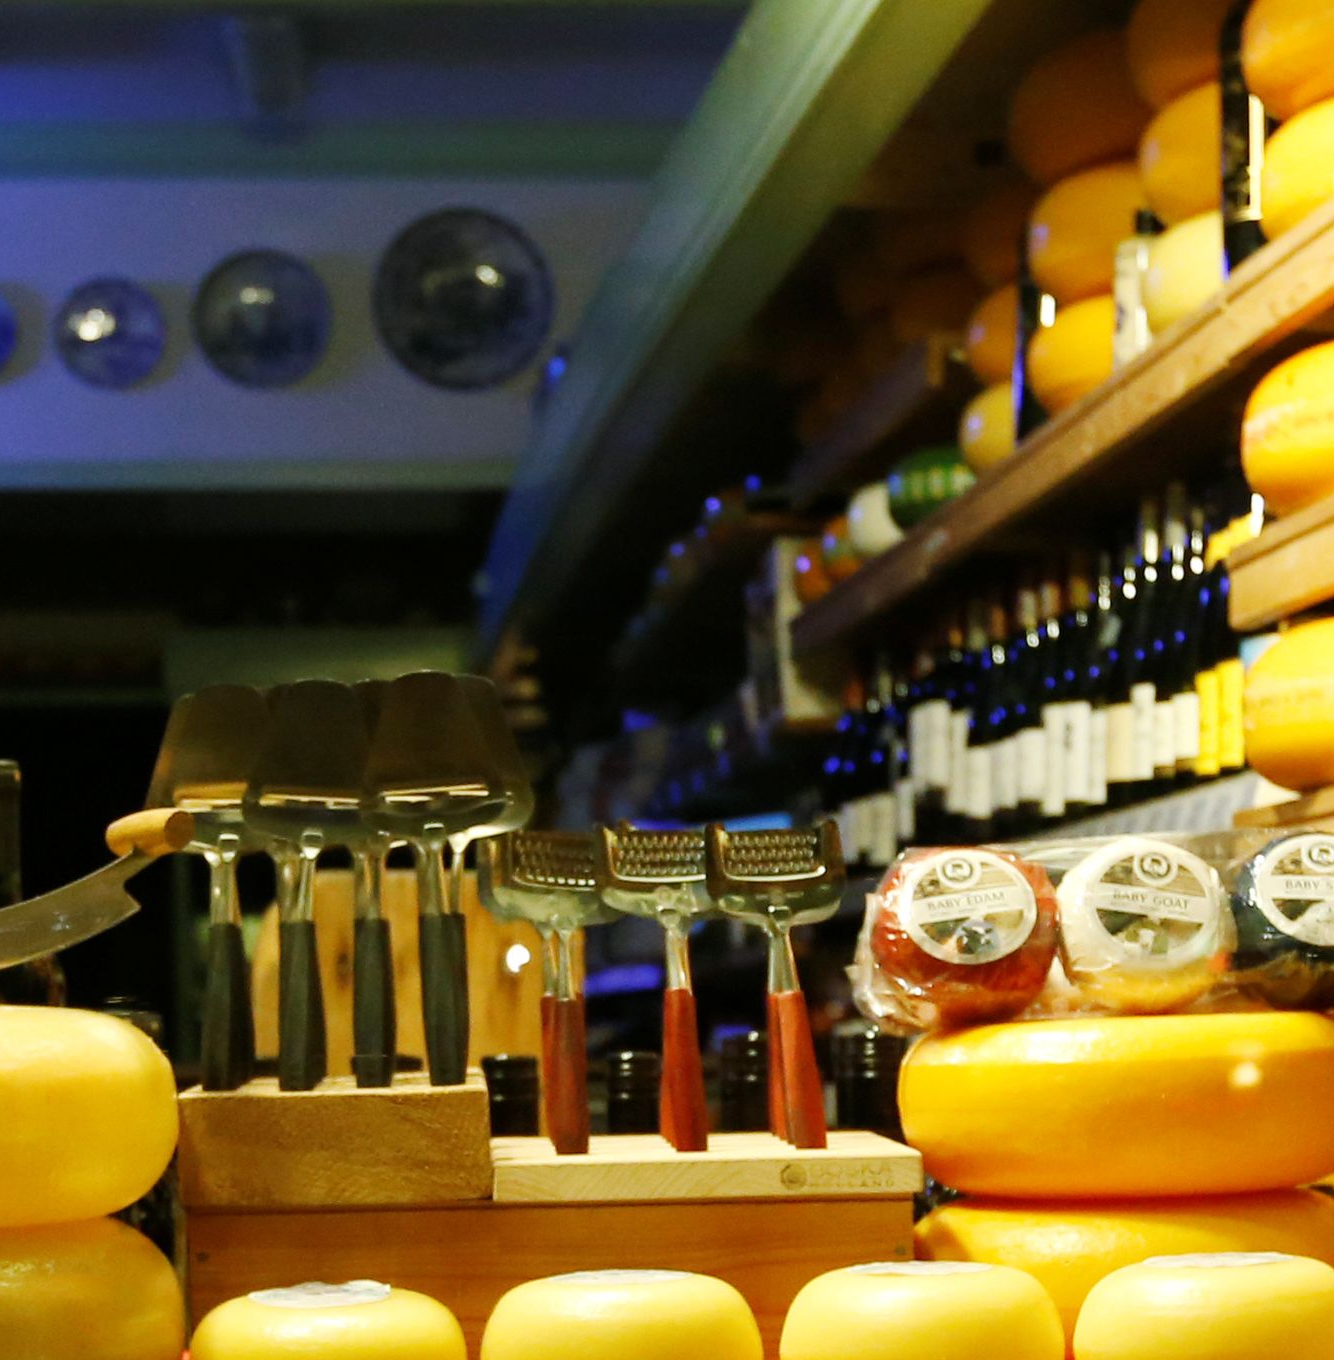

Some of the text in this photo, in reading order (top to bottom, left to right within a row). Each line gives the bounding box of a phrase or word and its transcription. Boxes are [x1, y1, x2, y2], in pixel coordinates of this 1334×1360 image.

[1284, 880, 1319, 890] BABY
[928, 890, 1006, 911] BABY EDAM
[1152, 897, 1189, 910] GOAT
